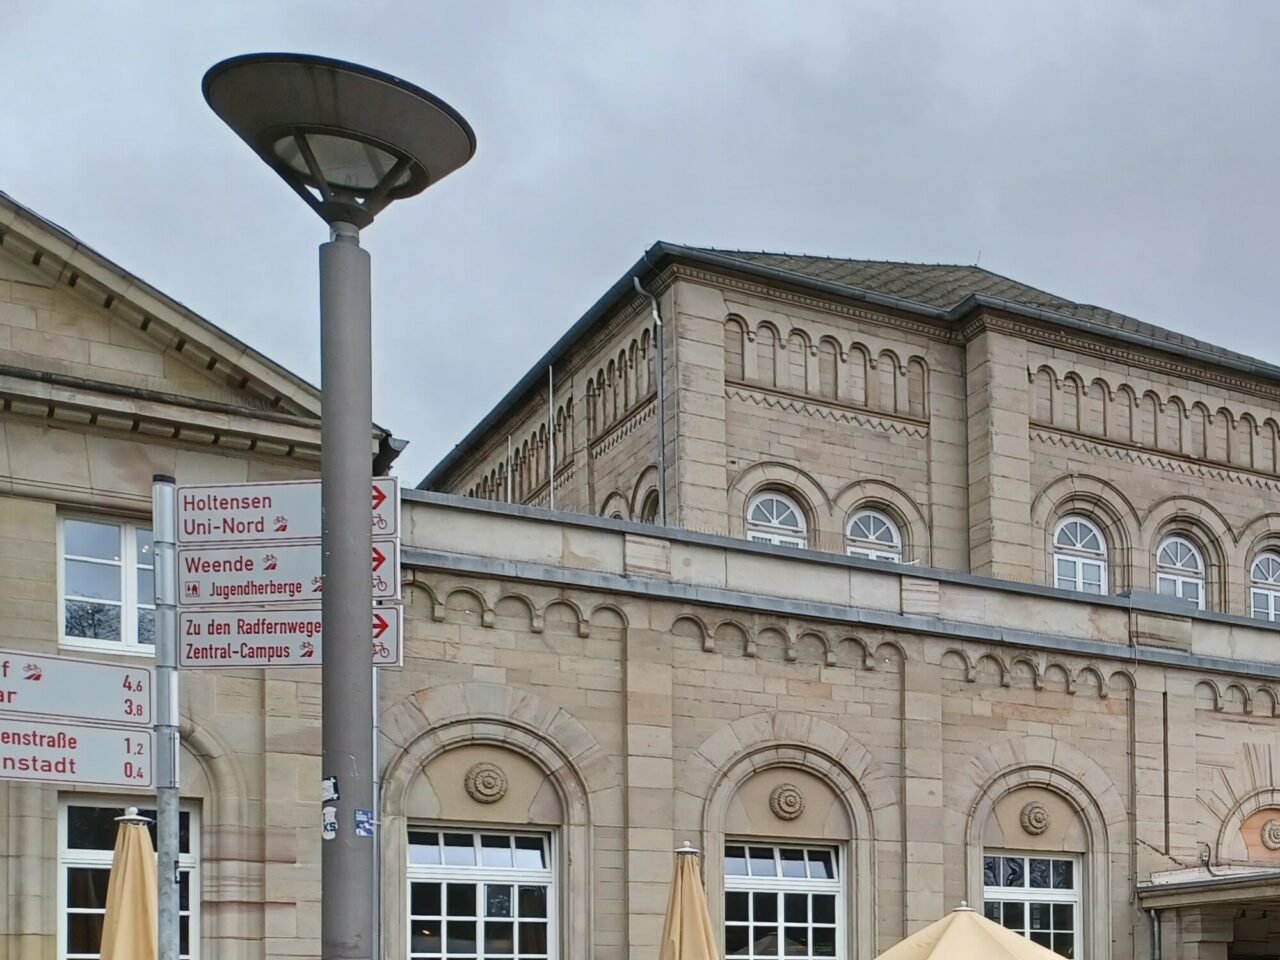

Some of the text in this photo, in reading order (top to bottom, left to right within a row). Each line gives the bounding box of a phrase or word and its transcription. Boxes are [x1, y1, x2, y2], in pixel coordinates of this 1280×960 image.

[184, 494, 272, 511] Holtensen
[184, 516, 264, 535] Uni-Nord
[185, 555, 254, 573] Weende
[210, 580, 302, 600] Jugendherberge
[186, 620, 201, 635] Zu
[208, 619, 231, 635] den
[186, 642, 290, 662] Zentral-Campus
[122, 674, 143, 692] 4.6
[124, 698, 143, 716] 3.8
[1, 731, 144, 755] enstraße 1.2
[3, 755, 144, 779] nstadt 0.4
